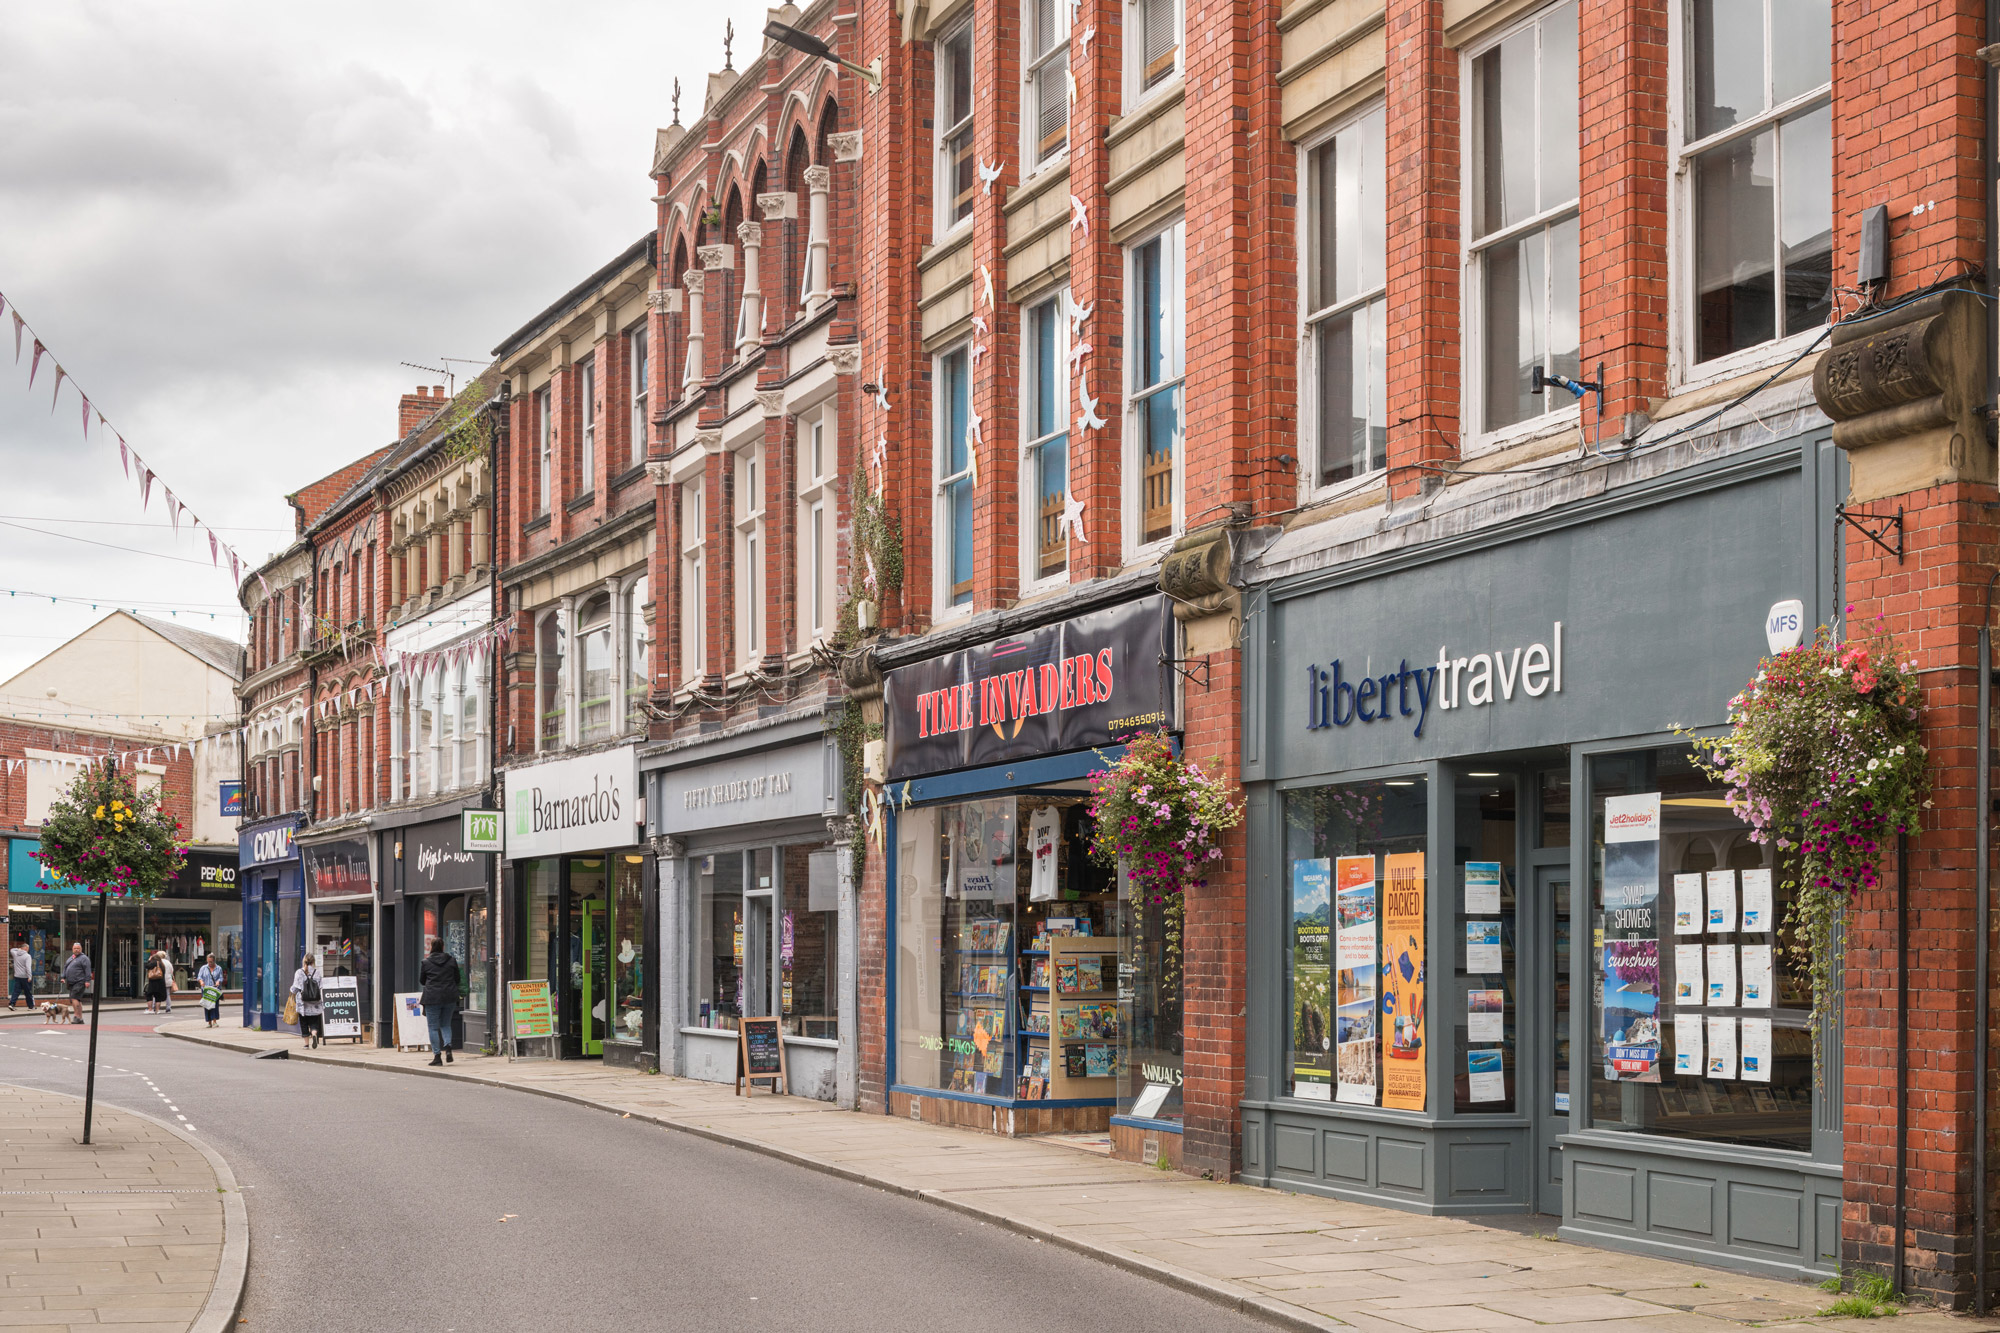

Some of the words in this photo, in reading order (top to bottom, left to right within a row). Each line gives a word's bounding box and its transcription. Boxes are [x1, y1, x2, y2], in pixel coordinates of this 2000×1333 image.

[1770, 614, 1798, 634] MFS
[916, 681, 974, 738] TIME
[979, 647, 1113, 726] INVADERS
[684, 788, 709, 809] FIFTY
[712, 779, 748, 804] SHADES
[752, 777, 765, 797] OF
[769, 772, 792, 794] TAN
[532, 774, 620, 833] Barnardo's
[254, 827, 289, 862] CORAL
[1303, 874, 1322, 882] INGHAMS
[1391, 867, 1416, 891] VALUE
[1388, 892, 1420, 916] PACKED
[1622, 885, 1645, 905] SWAP
[1615, 908, 1651, 929] SHOWERS
[1300, 935, 1315, 943] BOOTS
[1315, 935, 1328, 943] OFF?
[1314, 926, 1321, 934] ON
[1322, 926, 1329, 934] OR
[1628, 932, 1640, 948] FOR
[1607, 952, 1658, 968] sunshine
[920, 1035, 943, 1050] COMICS
[1616, 1048, 1628, 1058] DON'T
[1629, 1049, 1640, 1058] MISS
[1640, 1050, 1649, 1059] OUT
[1142, 1063, 1183, 1086] ANNUALS
[1621, 1061, 1631, 1070] BOOK
[1406, 1075, 1421, 1083] VALUE
